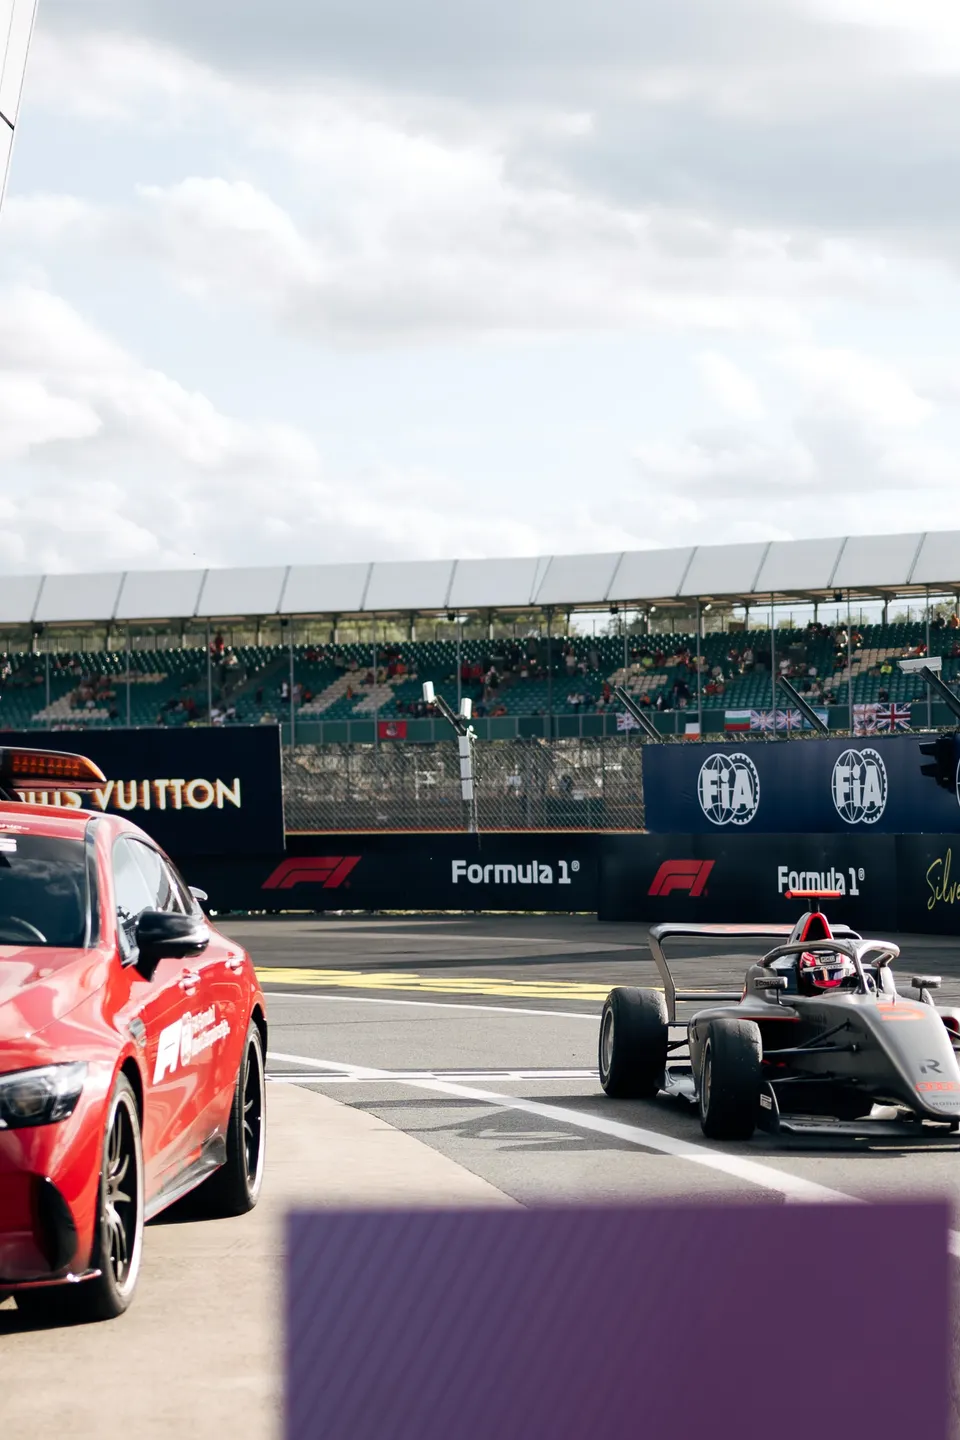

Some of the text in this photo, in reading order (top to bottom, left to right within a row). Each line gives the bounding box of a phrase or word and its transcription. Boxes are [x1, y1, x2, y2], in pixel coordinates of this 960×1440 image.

[94, 778, 241, 811] VUITTON
[452, 860, 553, 884] Formula
[778, 866, 846, 896] Formula
